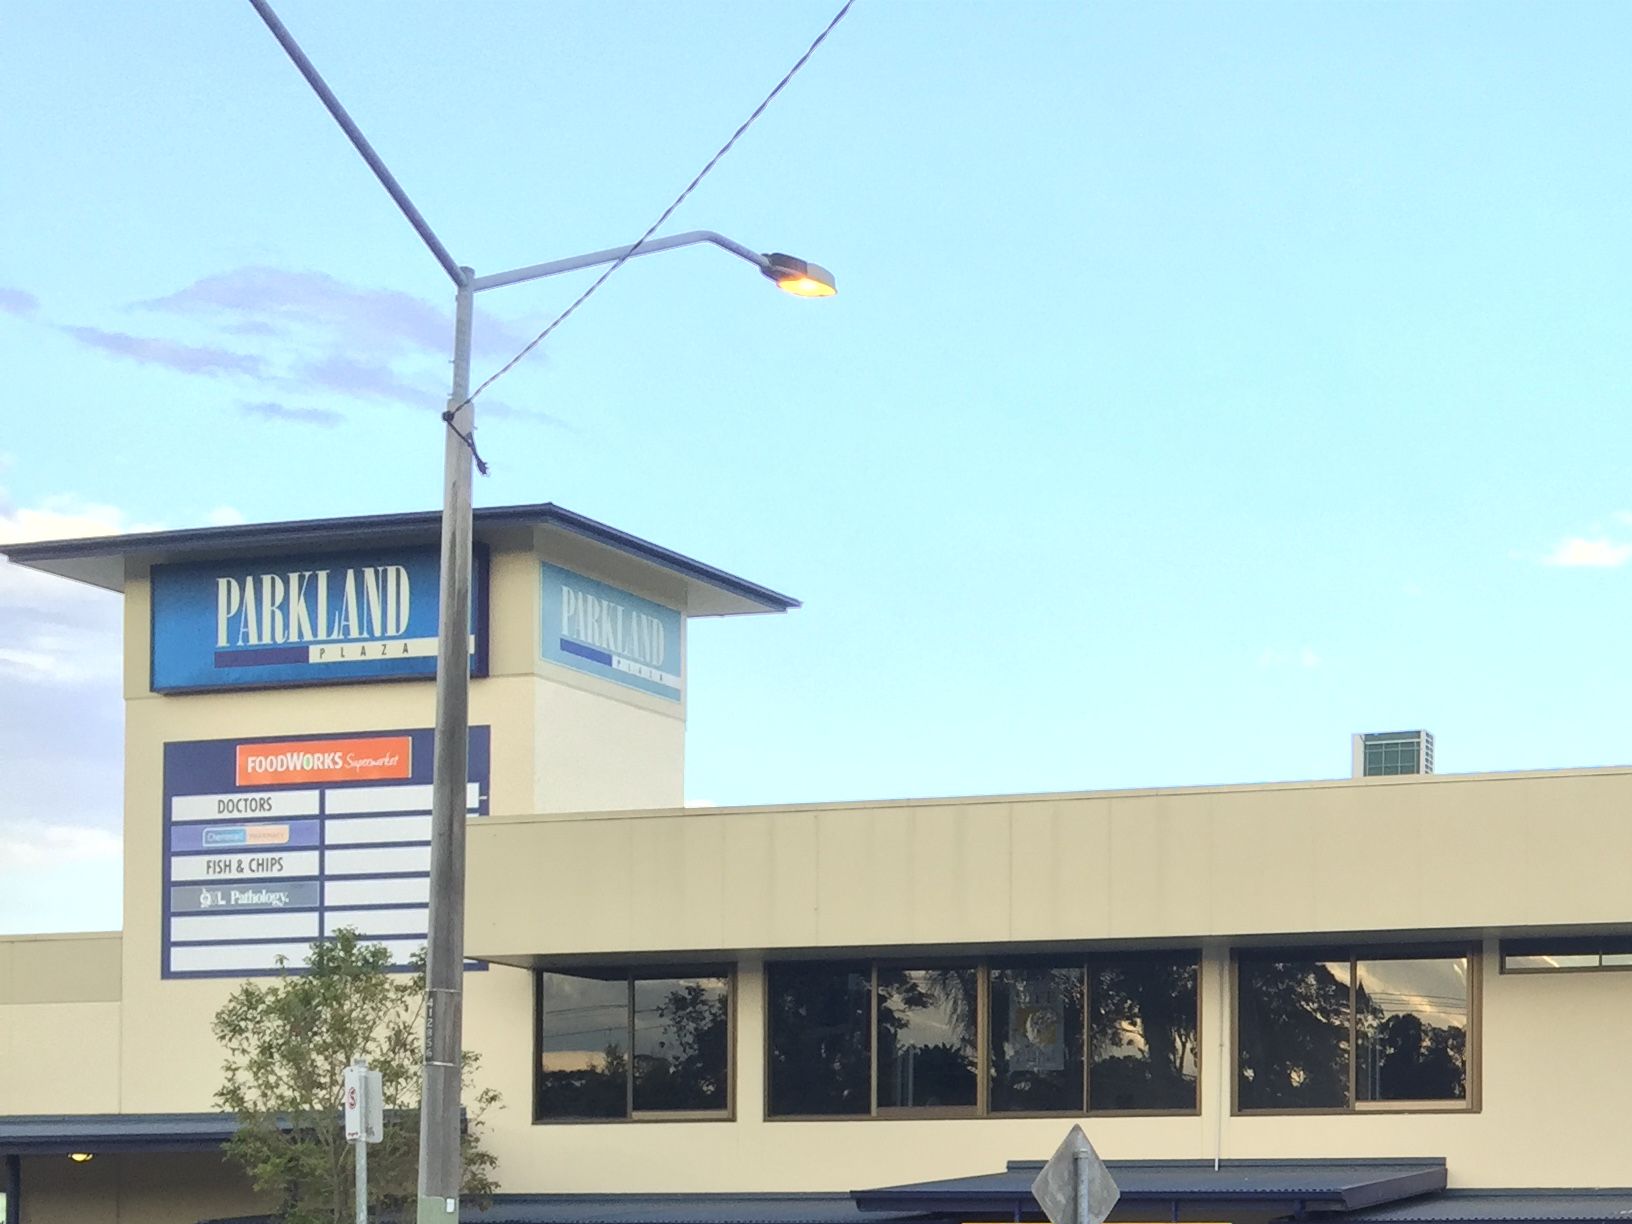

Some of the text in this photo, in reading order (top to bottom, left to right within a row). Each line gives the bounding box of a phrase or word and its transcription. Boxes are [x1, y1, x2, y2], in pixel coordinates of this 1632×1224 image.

[216, 565, 411, 647] PARKLAND
[561, 585, 665, 667] PARKLAND
[319, 642, 409, 659] PLAZA
[247, 752, 342, 773] FOODWORKS
[217, 797, 272, 814] DOCTORS
[206, 857, 284, 875] FISH & CHIPS
